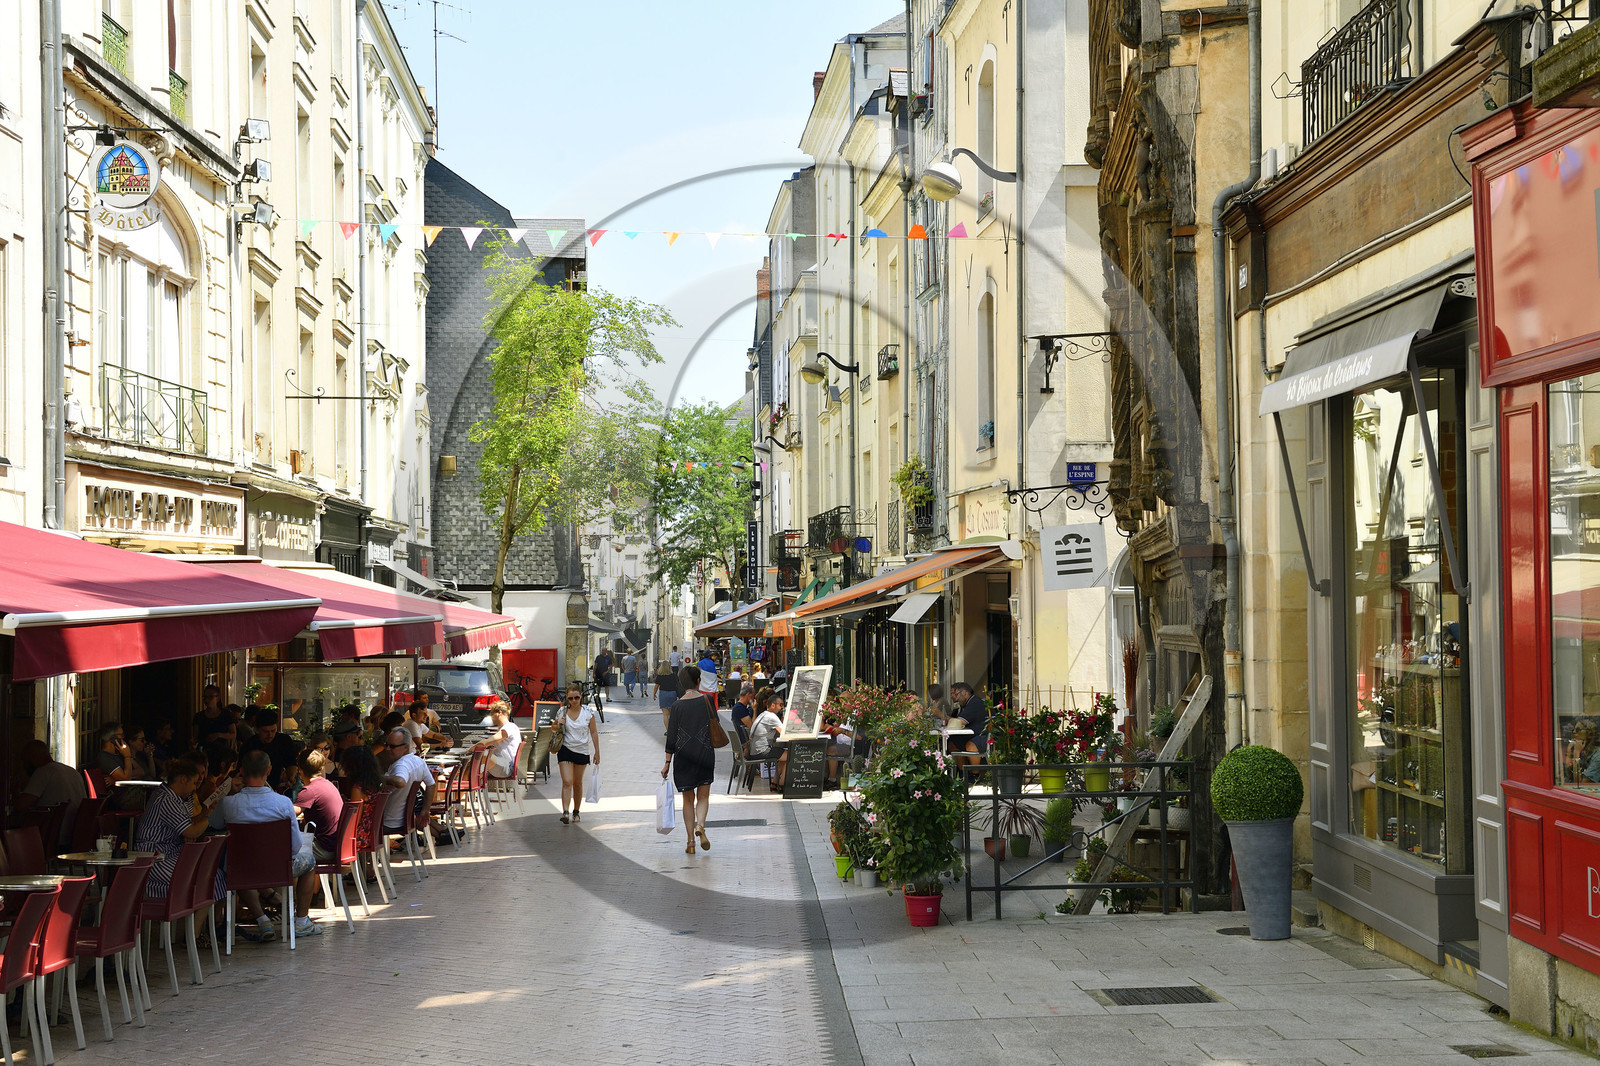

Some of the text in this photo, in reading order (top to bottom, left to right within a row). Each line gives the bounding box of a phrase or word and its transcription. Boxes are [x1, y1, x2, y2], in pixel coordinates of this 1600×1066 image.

[97, 208, 152, 229] Hôtel
[1297, 374, 1322, 402] Bijoux
[1322, 365, 1333, 390] de
